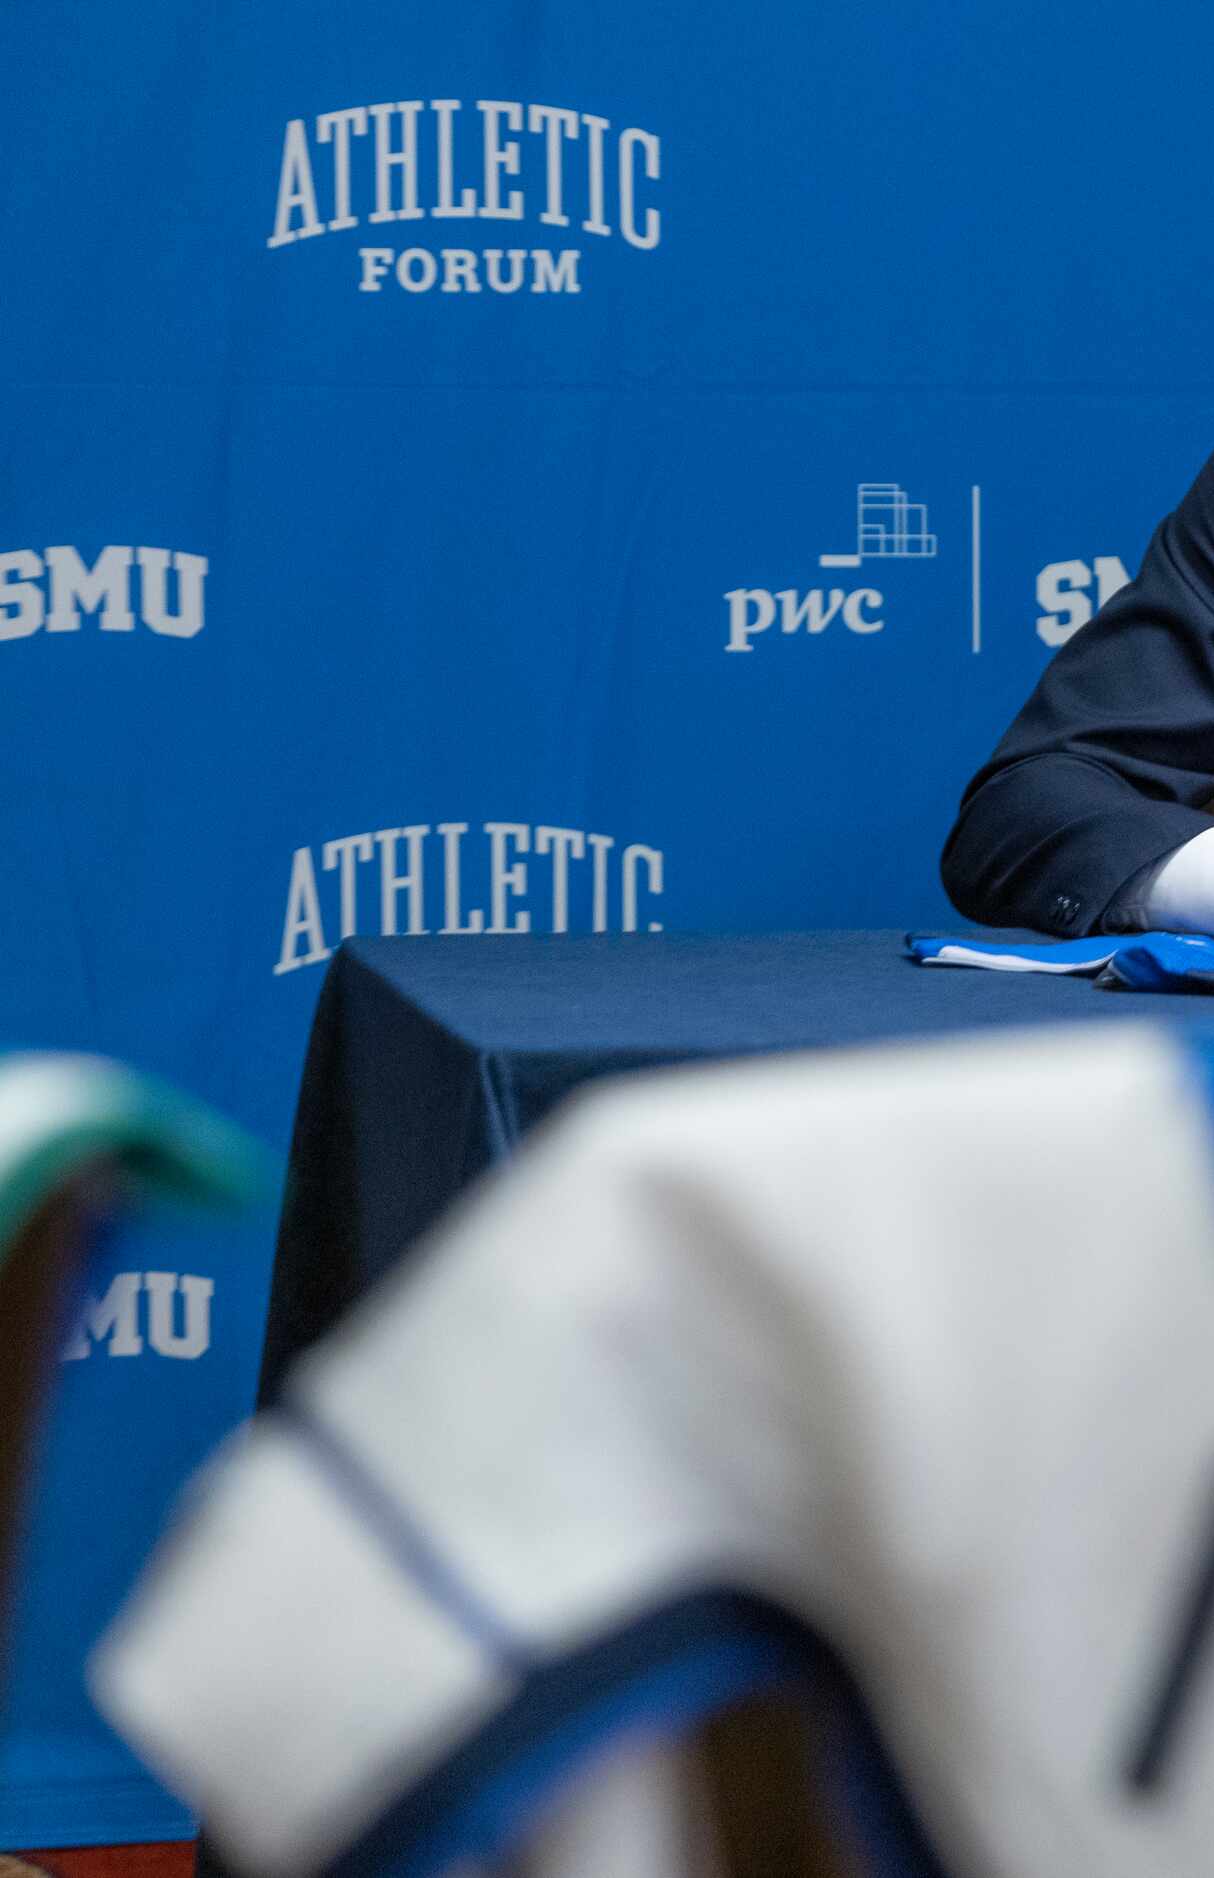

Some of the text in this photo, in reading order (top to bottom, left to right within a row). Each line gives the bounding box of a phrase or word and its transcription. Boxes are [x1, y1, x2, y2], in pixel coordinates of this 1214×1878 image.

[267, 99, 660, 251] ATHLETIC
[359, 247, 581, 293] FORUM
[0, 545, 208, 641] SMU
[724, 588, 884, 652] pwc
[273, 822, 664, 975] ATHLETIC
[60, 1271, 214, 1360] MU
